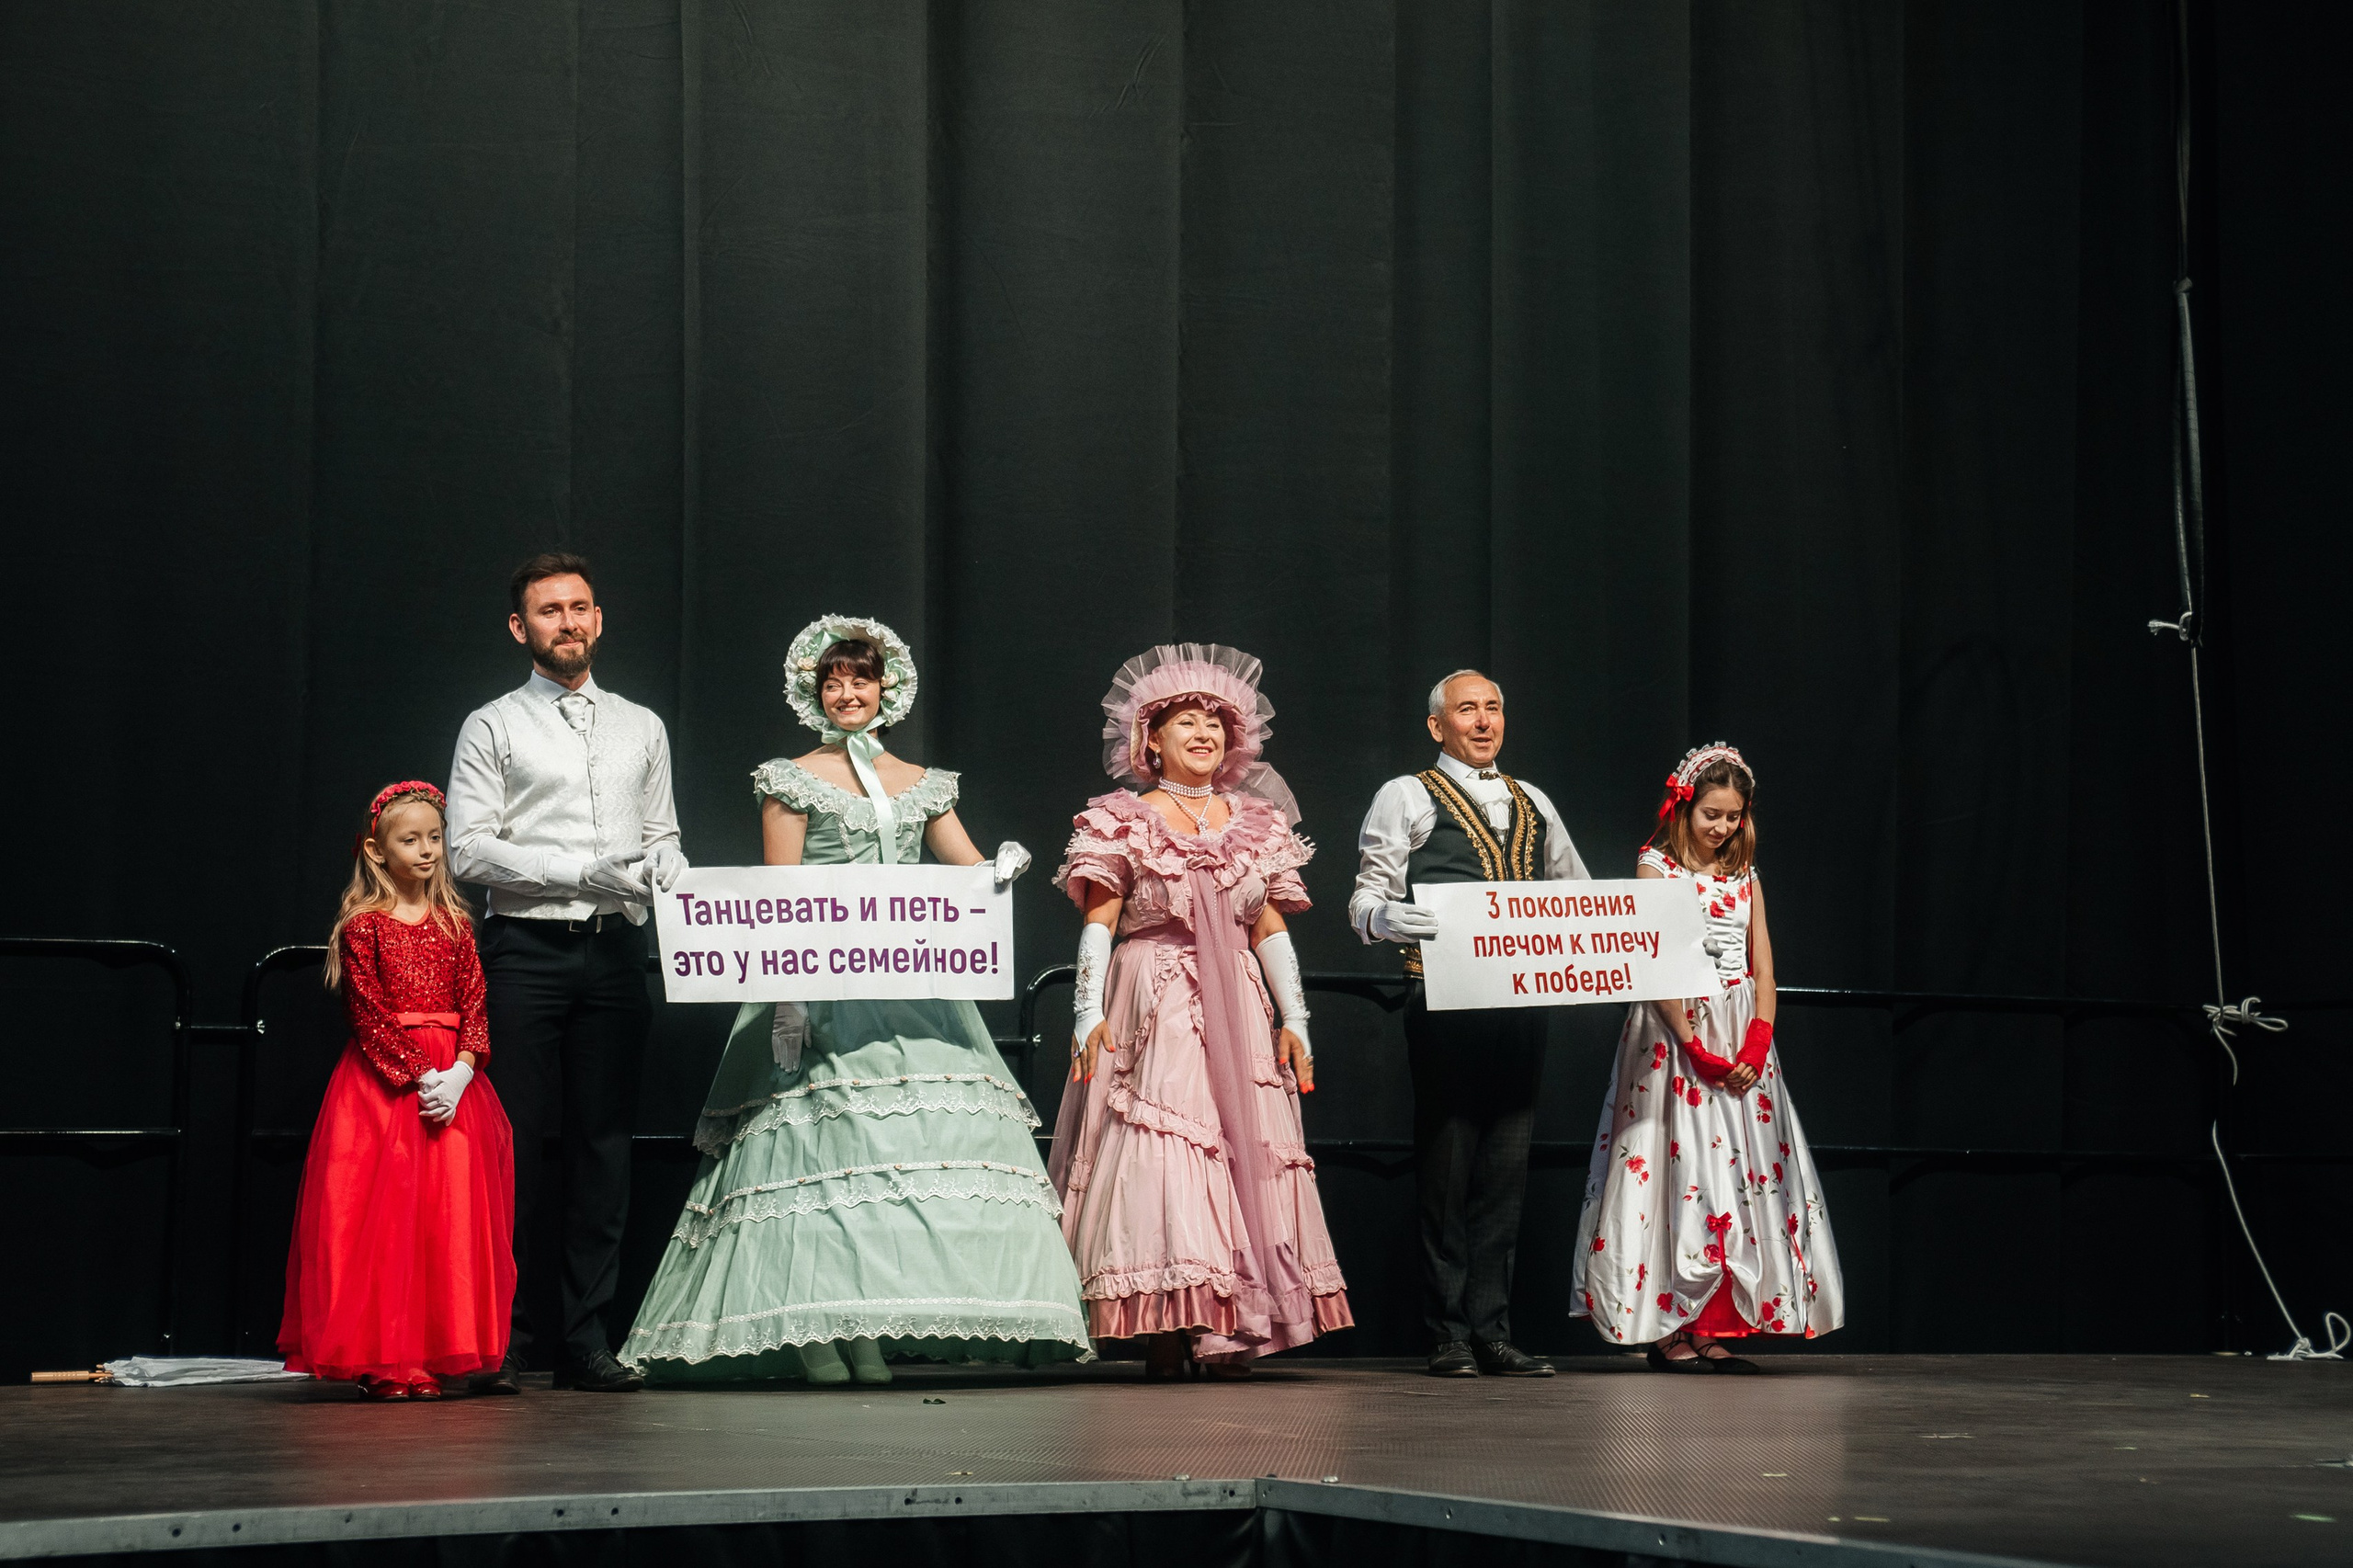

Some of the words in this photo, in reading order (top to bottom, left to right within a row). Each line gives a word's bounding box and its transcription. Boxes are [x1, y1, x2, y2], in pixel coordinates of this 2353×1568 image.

[676, 892, 849, 930] Танцевать
[859, 896, 878, 923] и
[889, 896, 960, 923] петь
[1485, 891, 1501, 920] 3
[1507, 894, 1637, 919] поколения
[673, 950, 725, 977] это
[733, 950, 750, 984] у
[760, 949, 820, 976] нас
[828, 938, 999, 975] семейное!
[1472, 934, 1563, 958] плечом
[1569, 933, 1586, 955] к
[1590, 930, 1660, 960] плечу
[1512, 972, 1529, 995] к
[1534, 962, 1633, 996] победе!
